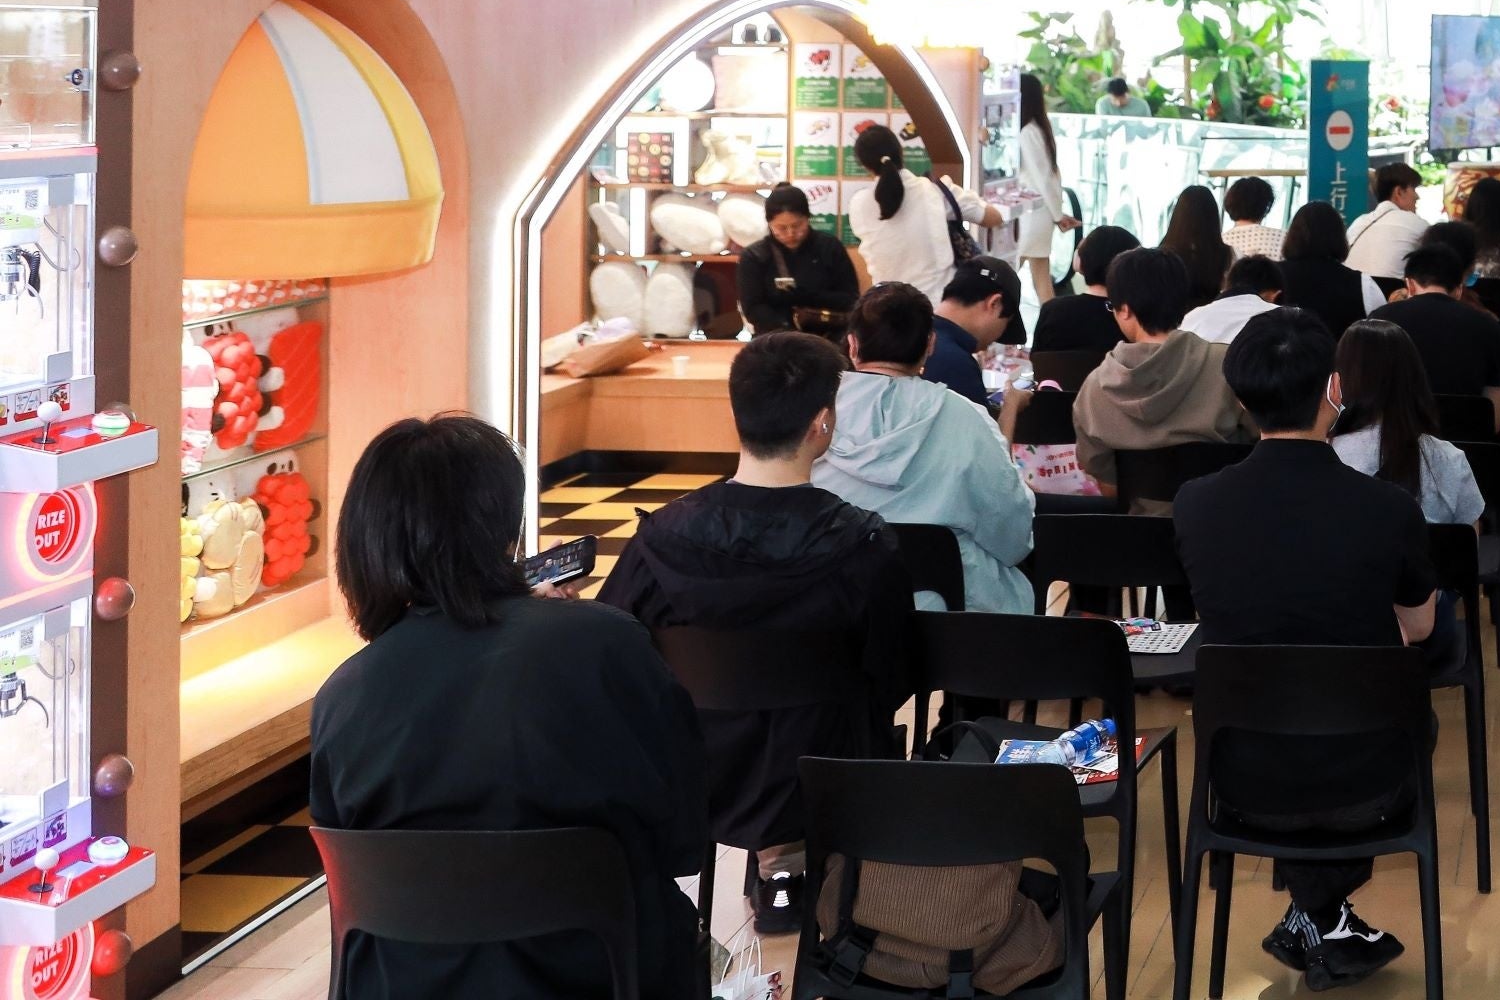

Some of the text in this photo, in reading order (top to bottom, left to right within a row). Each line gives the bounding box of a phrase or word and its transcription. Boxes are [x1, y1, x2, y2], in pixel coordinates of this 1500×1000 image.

[1330, 160, 1347, 219] 上行
[38, 510, 65, 529] RIZE
[35, 531, 60, 549] OUT
[32, 959, 60, 988] OUT
